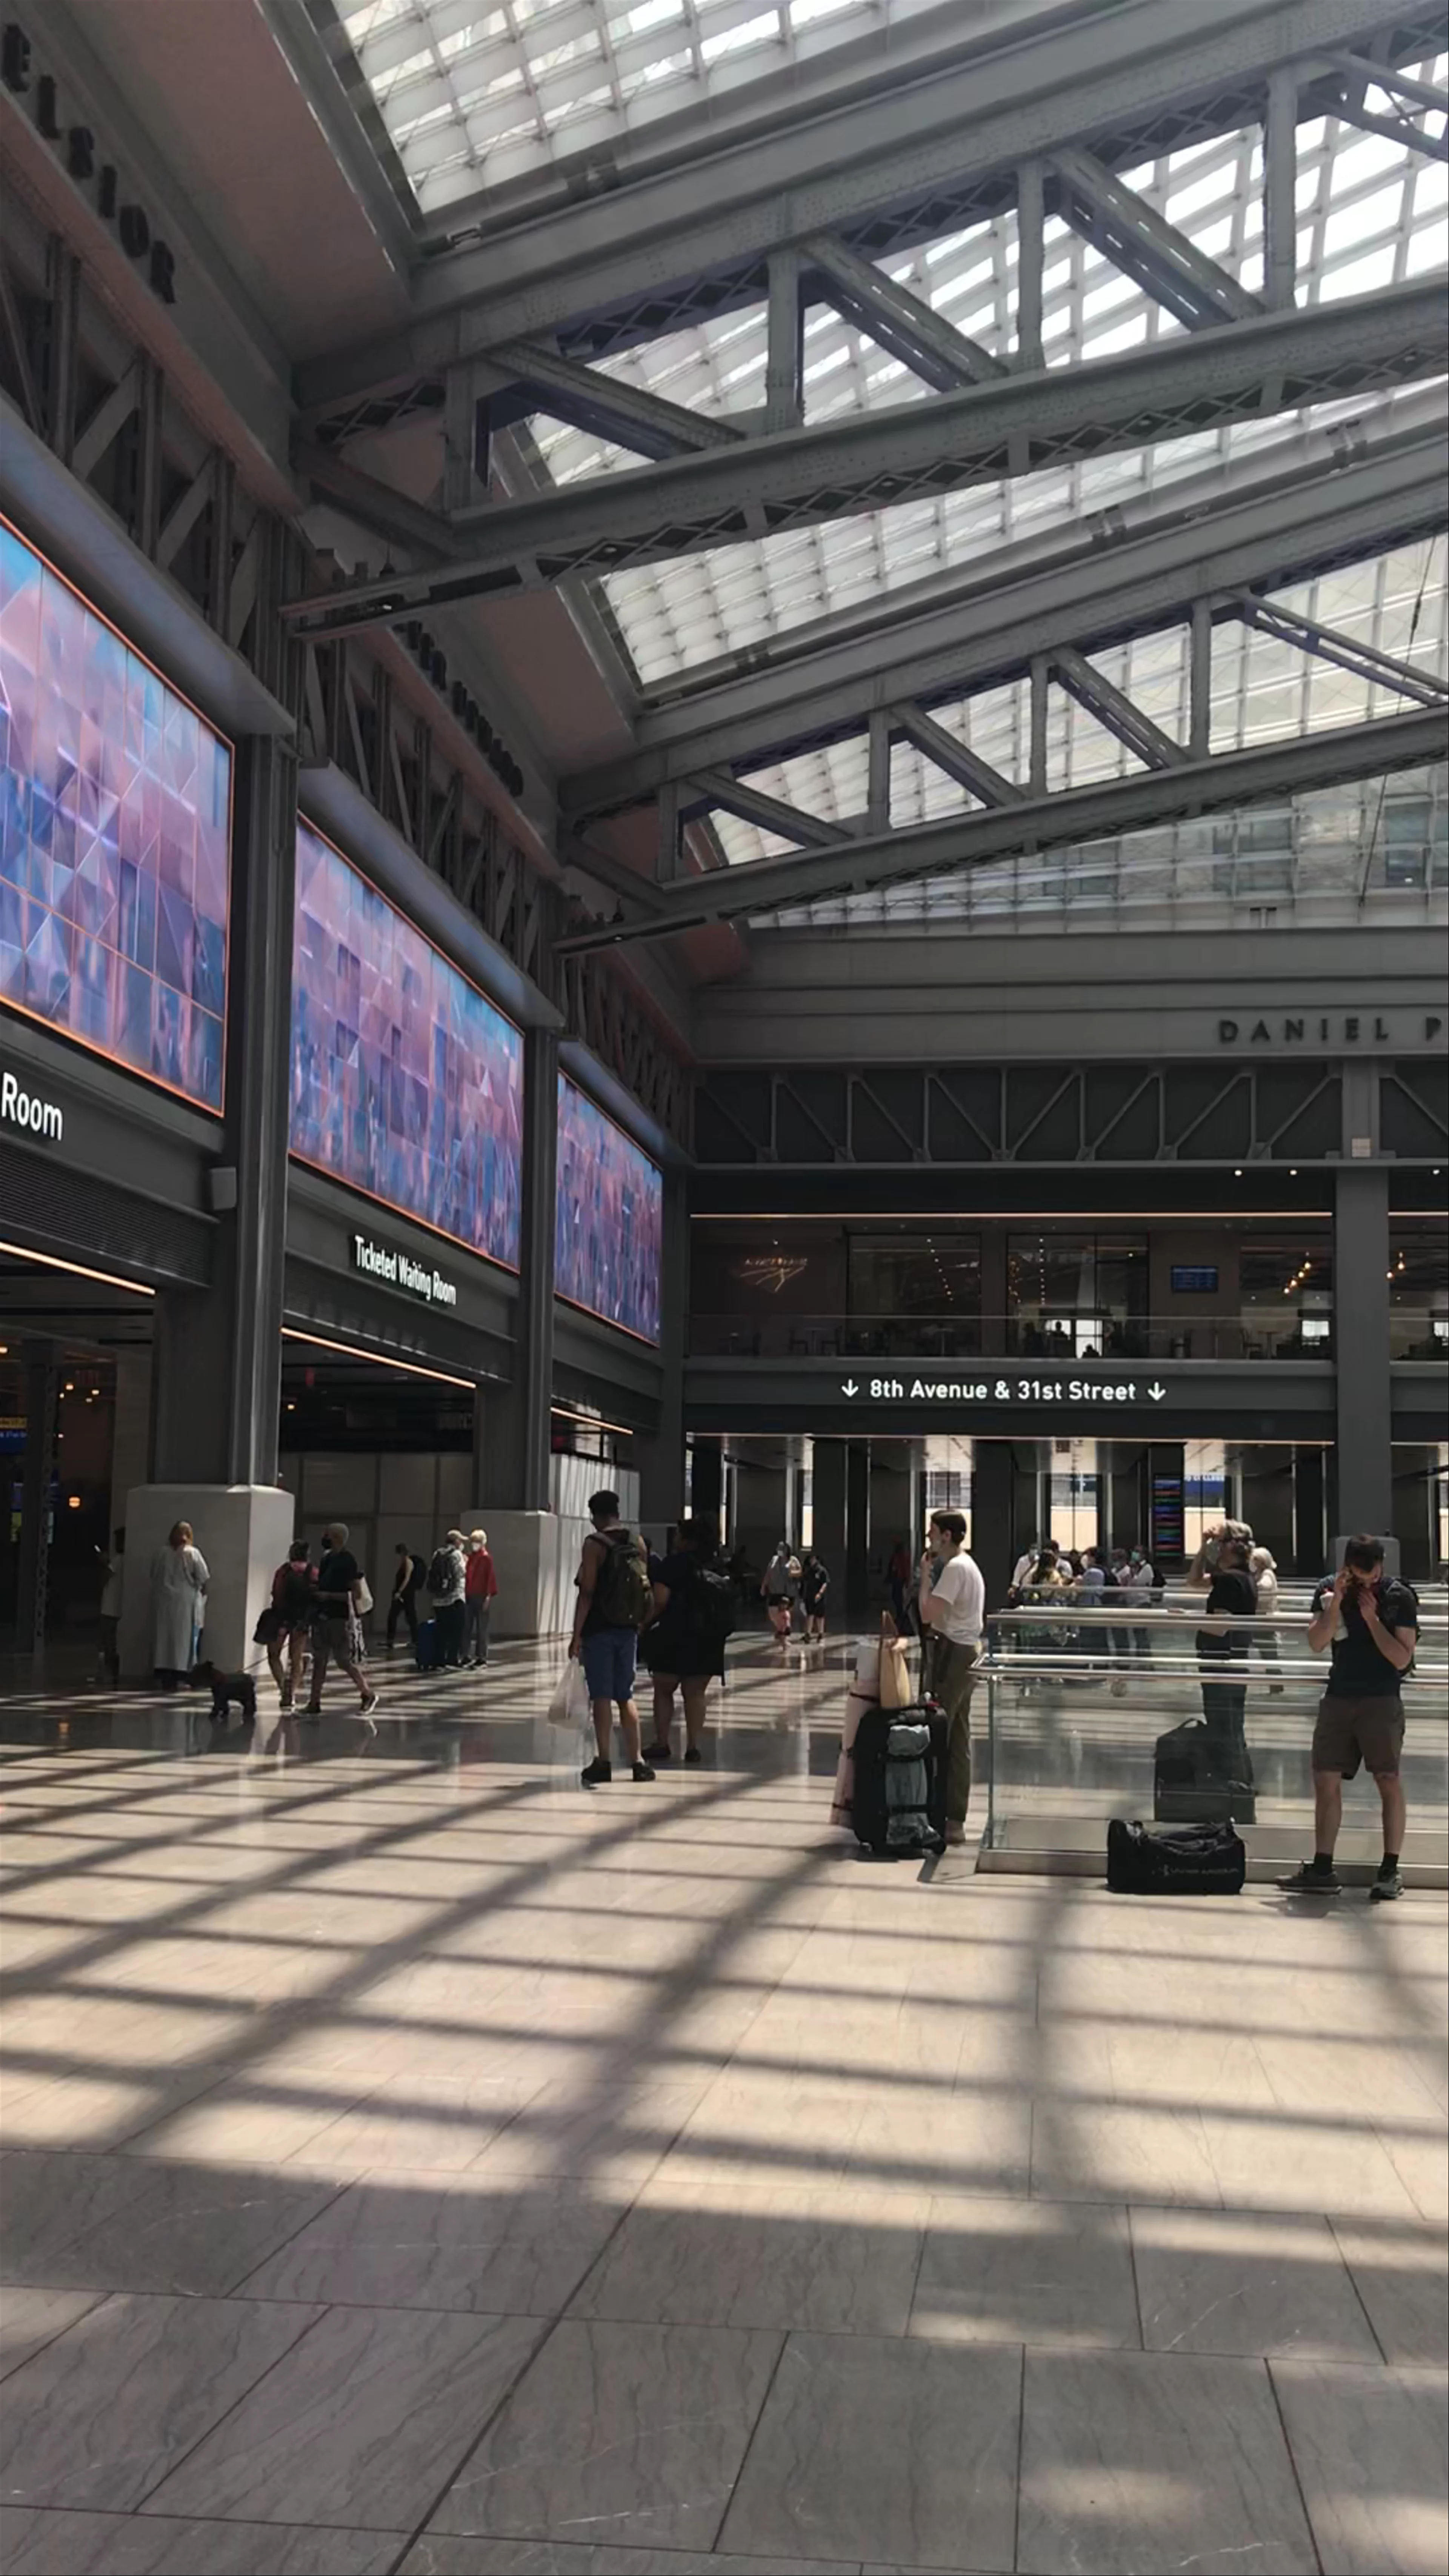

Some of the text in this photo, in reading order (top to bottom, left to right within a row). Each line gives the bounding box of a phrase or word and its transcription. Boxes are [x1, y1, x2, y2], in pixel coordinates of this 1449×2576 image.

[1218, 1017, 1443, 1043] DANIEL P
[2, 1072, 63, 1141] Room
[355, 1235, 456, 1305] Ticketed Waiting Room
[870, 1380, 1136, 1401] 8th Avenue & 31st Street
